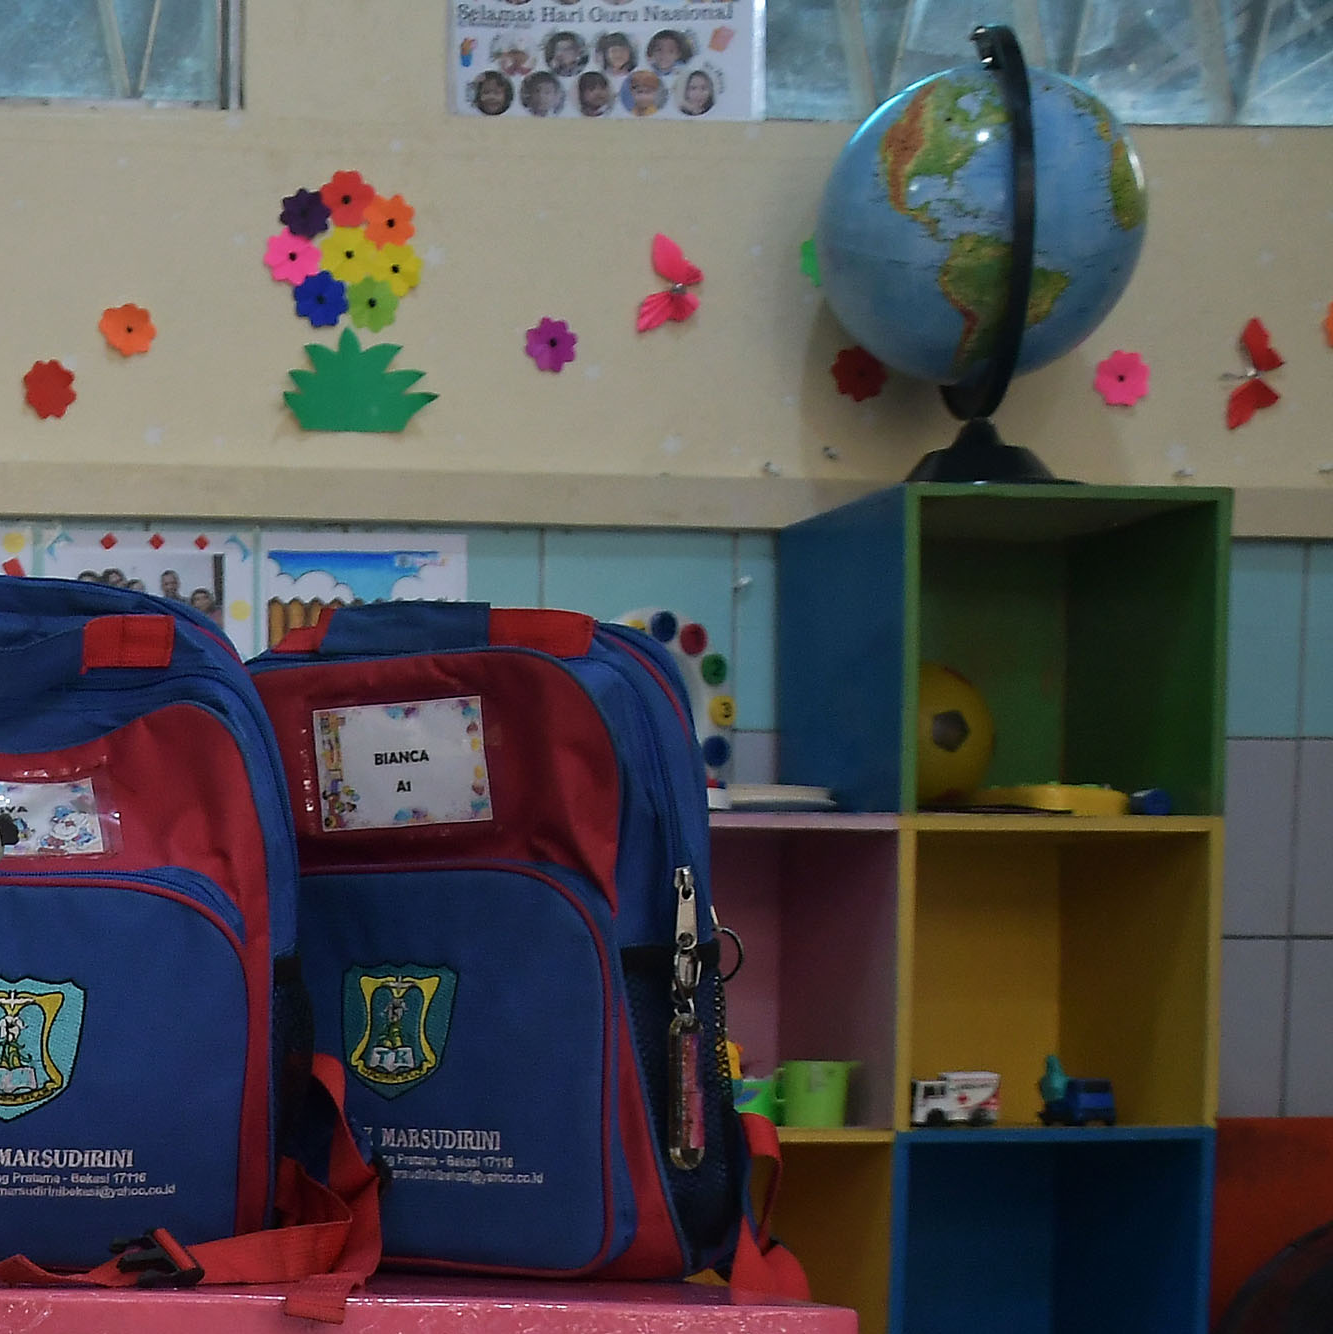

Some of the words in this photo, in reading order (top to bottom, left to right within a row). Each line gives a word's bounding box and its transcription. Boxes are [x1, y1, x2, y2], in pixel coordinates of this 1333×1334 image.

[541, 7, 583, 22] Hari
[589, 7, 638, 23] Guru
[374, 749, 429, 765] BIANCA
[397, 780, 411, 792] A1
[381, 1127, 501, 1150] MARSUDIRINI
[13, 1172, 60, 1184] Pratama
[71, 1172, 110, 1184] Bekasi
